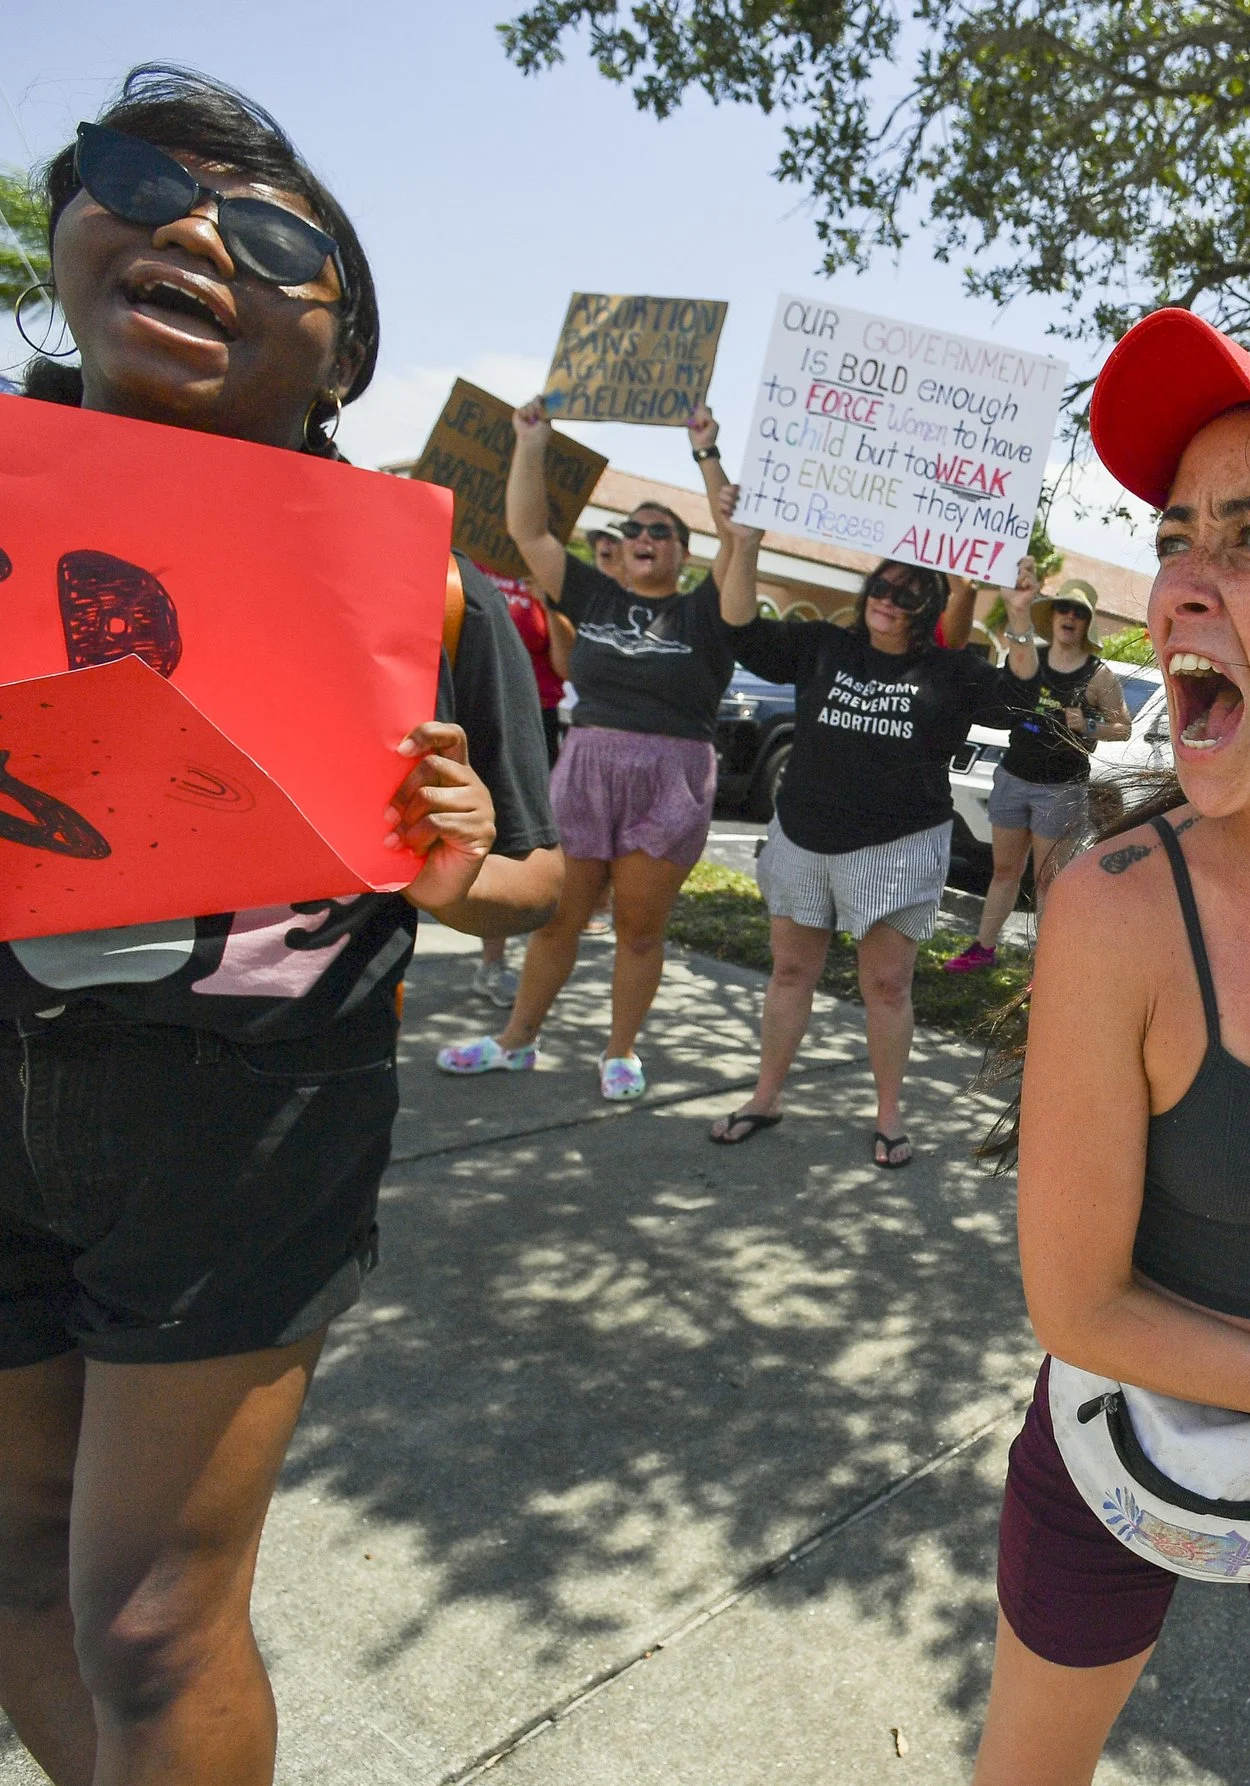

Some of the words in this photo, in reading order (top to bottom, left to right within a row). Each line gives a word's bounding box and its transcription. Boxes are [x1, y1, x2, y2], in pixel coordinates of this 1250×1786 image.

[569, 295, 721, 333] ABORTION
[563, 328, 641, 358] BANS
[650, 333, 703, 359] ARE
[783, 301, 840, 340] OUR
[862, 320, 1059, 392] GOVERNMENT
[551, 351, 667, 386] AGAINST
[675, 362, 709, 387] MY
[801, 348, 828, 375] IS
[838, 352, 908, 395] BOLD
[568, 384, 700, 418] RELIGION
[763, 374, 797, 407] to
[806, 382, 884, 425] FORCE
[953, 420, 977, 450] to
[982, 427, 1033, 463] have
[759, 416, 780, 442] a
[785, 417, 849, 458] child
[856, 433, 900, 469] but
[904, 445, 937, 480] too
[935, 452, 1012, 496] WEAK
[758, 449, 790, 483] to
[798, 458, 904, 509] ENSURE
[913, 486, 969, 532] they
[744, 481, 768, 513] it
[773, 487, 800, 522] to
[805, 492, 885, 543] Recess
[892, 525, 1006, 581] ALIVE!
[827, 686, 911, 713] PREVENTS
[818, 706, 914, 739] ABORTIONS
